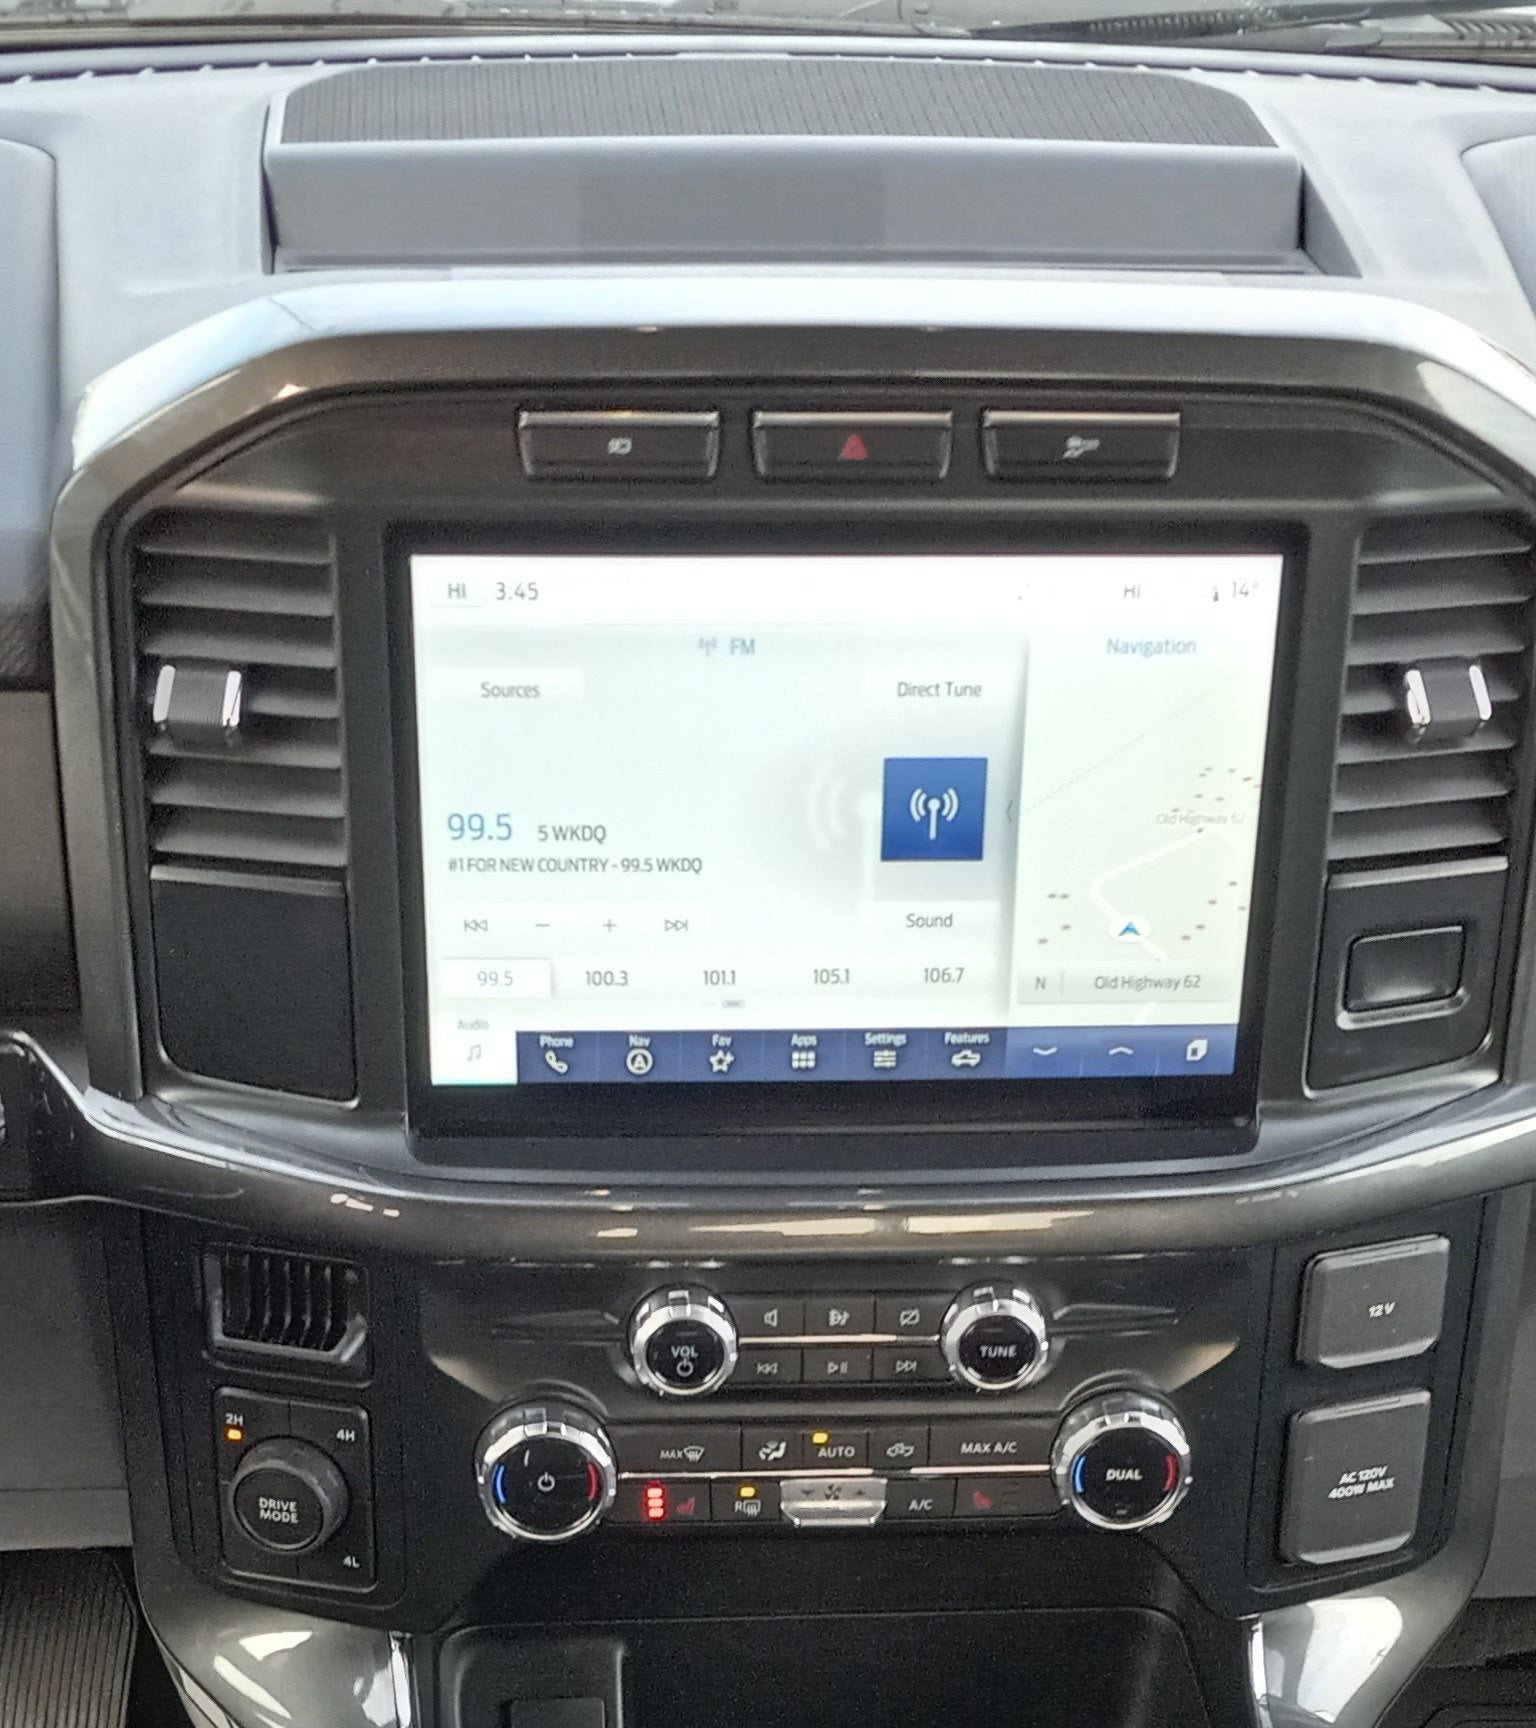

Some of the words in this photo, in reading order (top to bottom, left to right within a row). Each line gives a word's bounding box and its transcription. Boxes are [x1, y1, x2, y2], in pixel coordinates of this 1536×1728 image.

[446, 582, 467, 600] HI
[495, 581, 540, 602] 3:45
[729, 638, 757, 656] FM
[1105, 637, 1197, 657] Navigation
[479, 681, 541, 700] Sources
[896, 681, 942, 699] Direct
[944, 681, 983, 699] Tune
[446, 812, 514, 842] 99.5
[537, 824, 548, 842] 5
[551, 824, 607, 846] WKDQ
[447, 857, 465, 874] #1
[466, 857, 497, 874] FOR
[498, 857, 535, 874] NEW
[537, 857, 609, 874] COUNTRY
[620, 857, 654, 874] 99.5
[655, 857, 703, 876] WKDQ
[905, 912, 954, 930] Sound
[477, 970, 514, 987] 99.5
[584, 969, 629, 987] 100.3
[701, 969, 737, 986] 101.1
[812, 968, 851, 986] 105.1
[922, 967, 965, 985] 106.7
[1034, 976, 1047, 990] N
[1093, 975, 1117, 991] Old
[1119, 975, 1181, 993] Highway
[1182, 974, 1202, 990] 62
[456, 1018, 490, 1032] Audio
[538, 1035, 574, 1049] Phone
[628, 1035, 651, 1048] Nav
[711, 1034, 733, 1048] Fav
[791, 1034, 818, 1051] Apps
[863, 1031, 908, 1048] Settings
[943, 1031, 990, 1046] Features
[670, 1345, 699, 1359] VOL
[979, 1345, 1019, 1359] TUNE
[224, 1412, 244, 1426] 2H
[336, 1428, 356, 1443] 4H
[659, 1449, 684, 1461] MAX
[817, 1446, 856, 1459] AUTO
[960, 1441, 991, 1454] MAX
[993, 1441, 1019, 1454] A/C
[1105, 1469, 1143, 1481] DUAL
[1366, 1477, 1395, 1494] MAX
[257, 1497, 298, 1512] DRIVE
[908, 1499, 934, 1511] A/C
[258, 1509, 299, 1524] MODE
[342, 1555, 361, 1569] 4L
